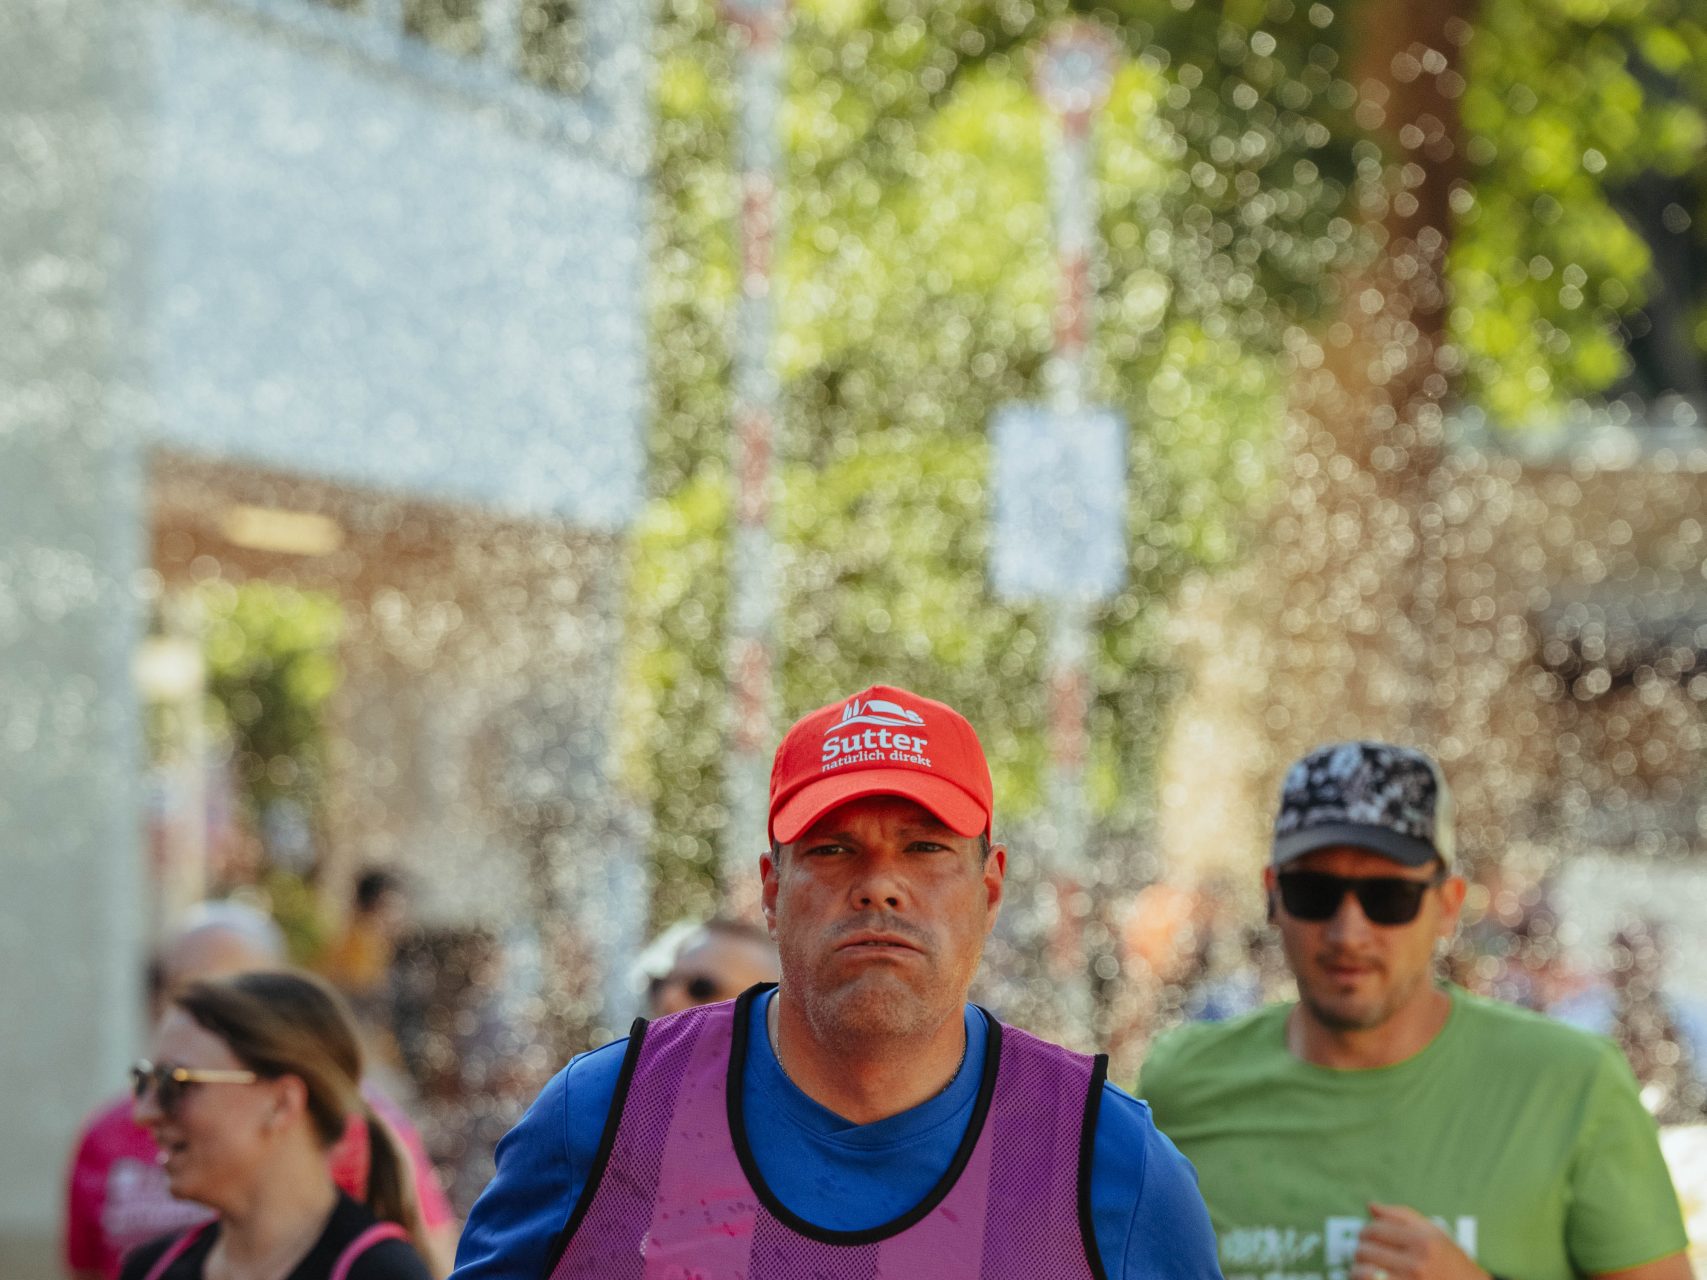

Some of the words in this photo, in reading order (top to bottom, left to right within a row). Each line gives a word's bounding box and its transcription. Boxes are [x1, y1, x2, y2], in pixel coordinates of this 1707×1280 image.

[821, 729, 927, 762] Sutter
[822, 749, 885, 773] natürlich
[889, 750, 932, 767] direkt
